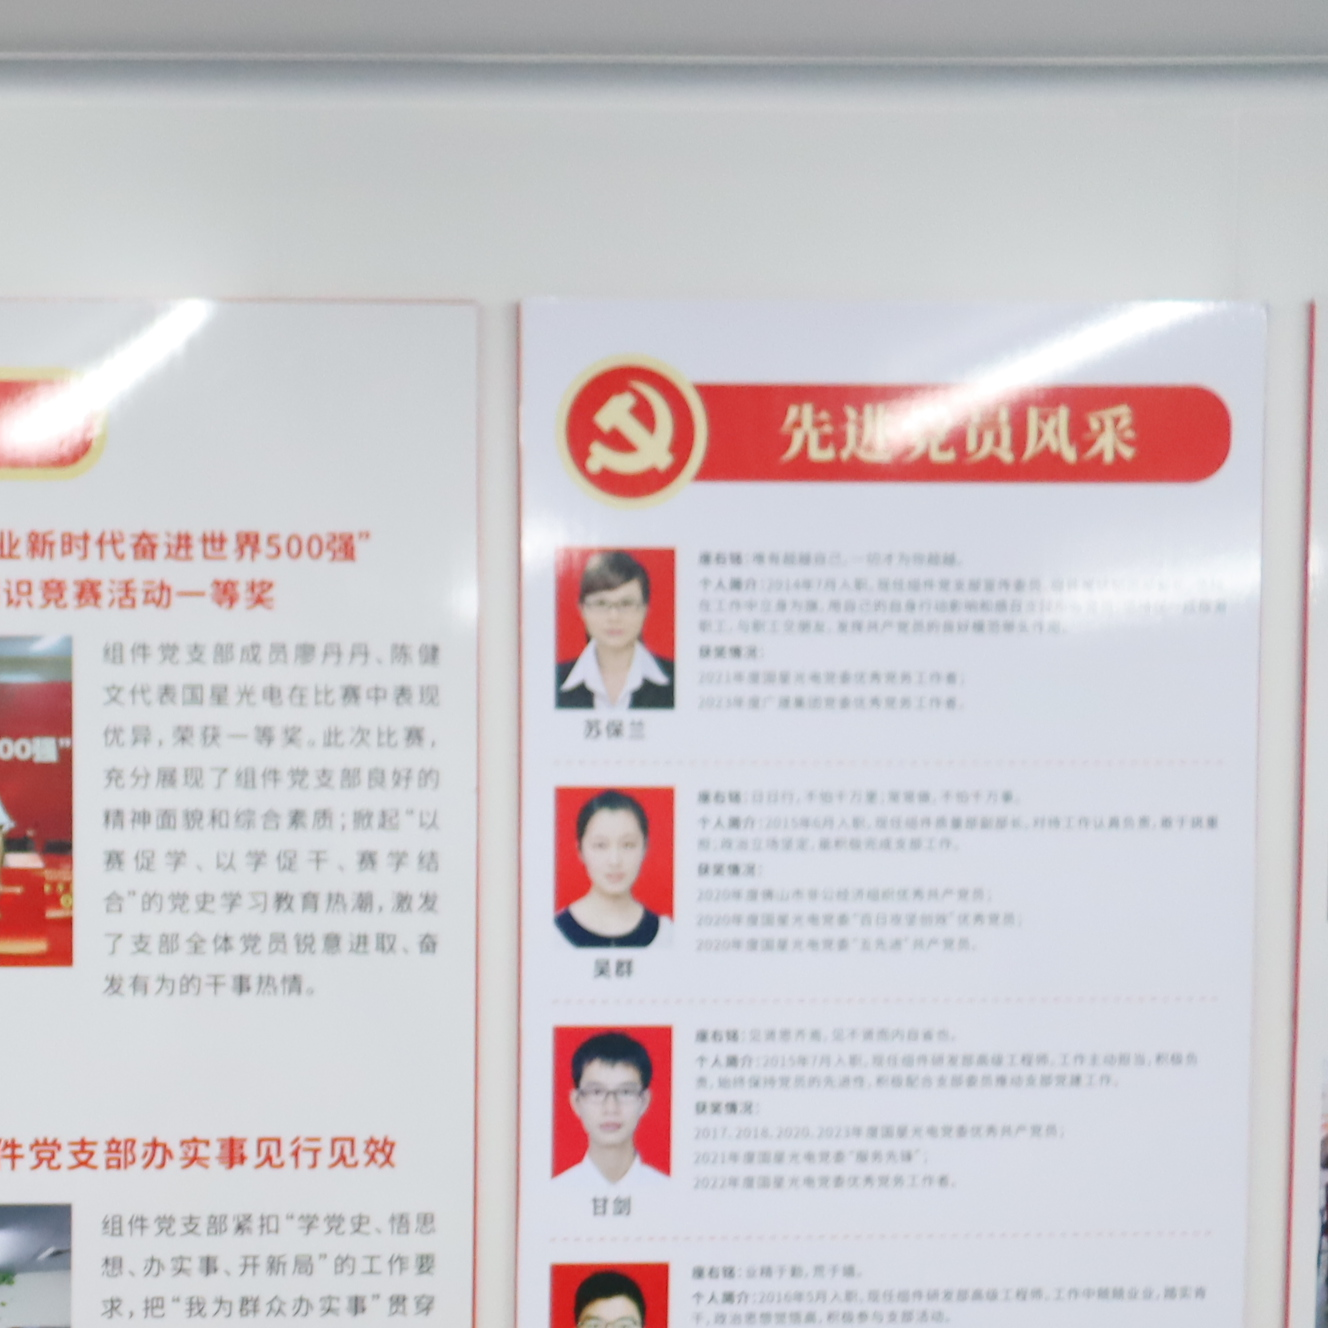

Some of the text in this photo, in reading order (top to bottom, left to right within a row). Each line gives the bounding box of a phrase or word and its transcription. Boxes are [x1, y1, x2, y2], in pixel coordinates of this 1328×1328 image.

[780, 404, 1138, 465] 先进党员风采
[584, 719, 646, 740] 苏保兰
[593, 958, 633, 979] 吴群
[591, 1196, 632, 1217] 甘剑
